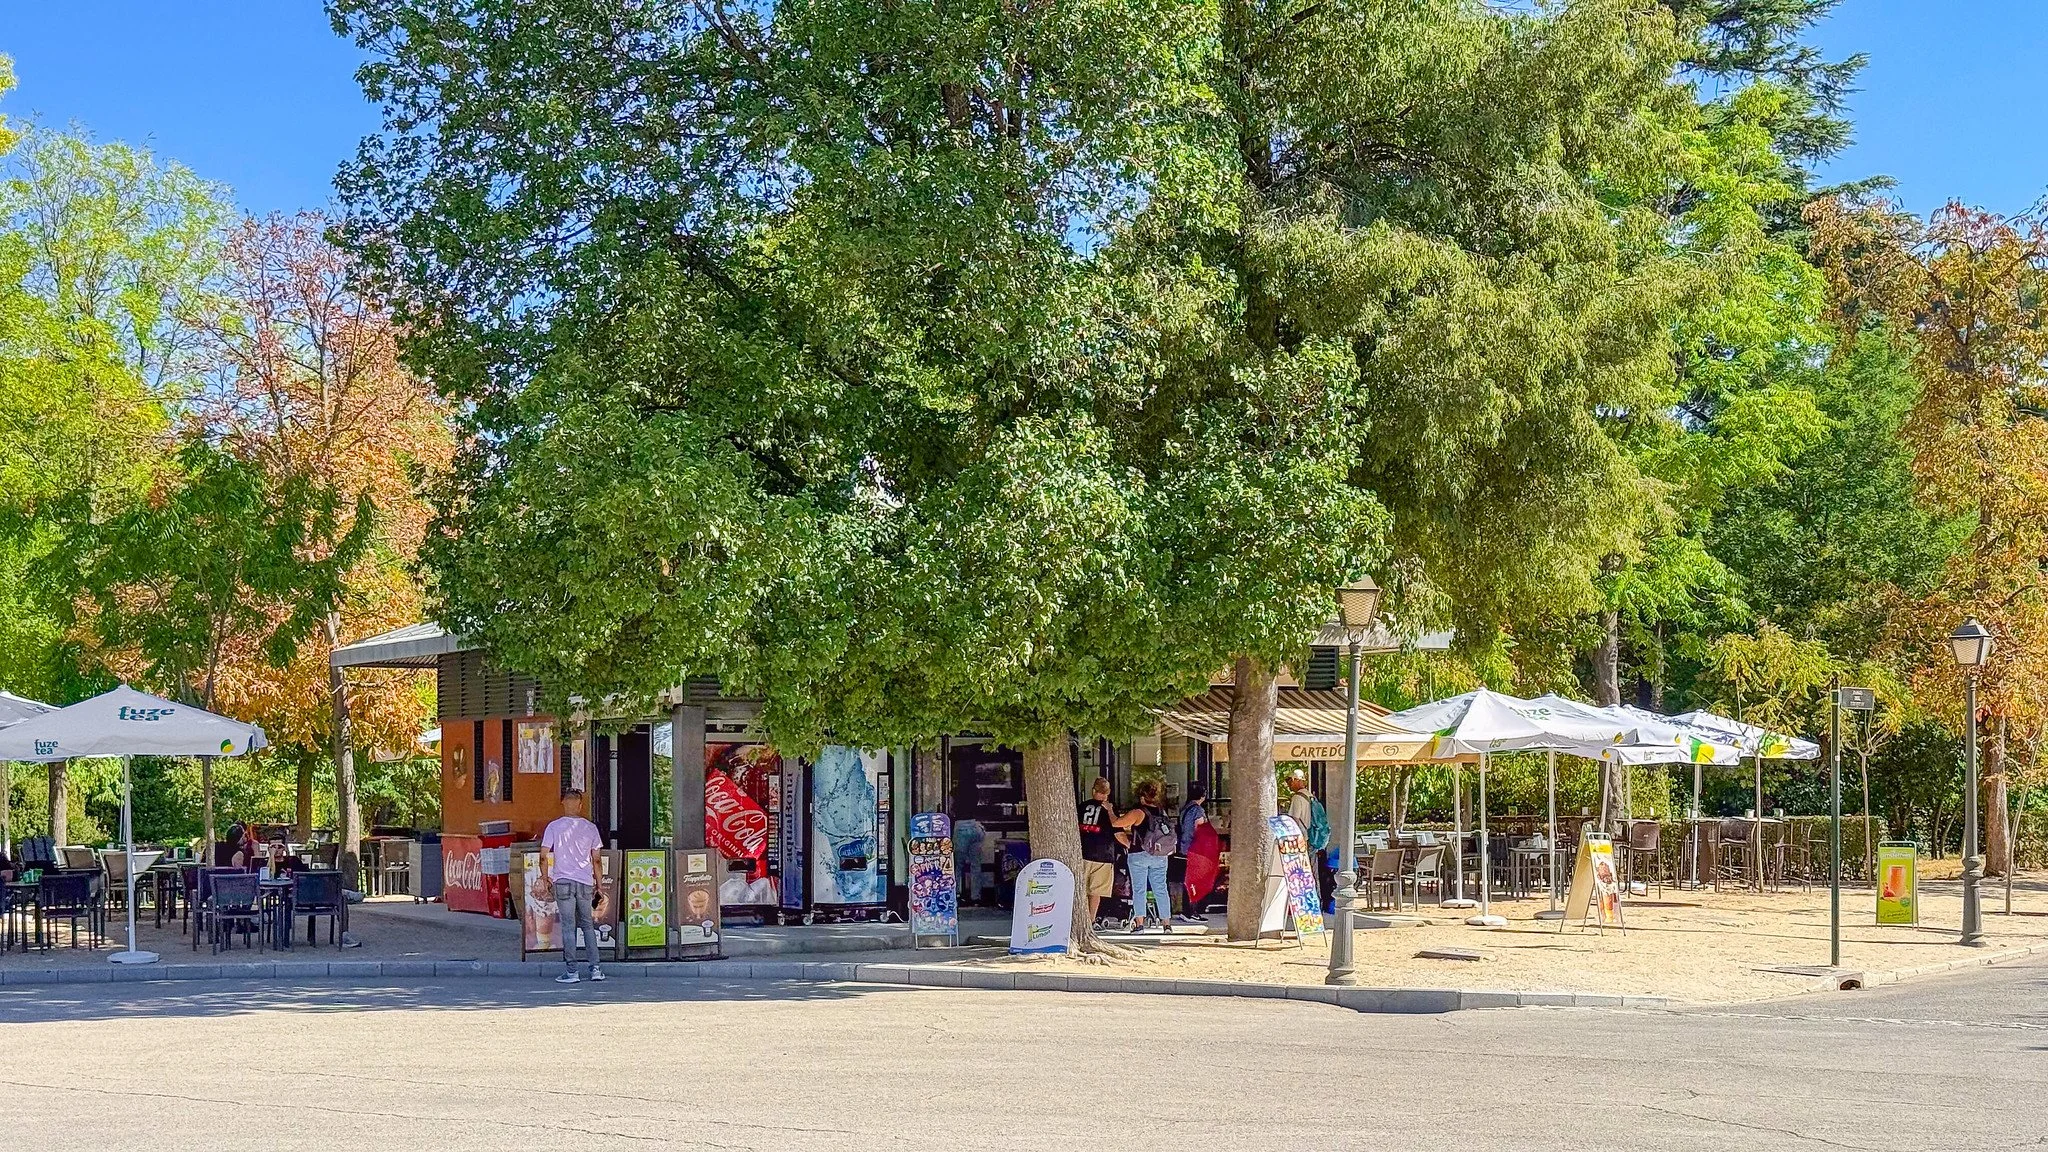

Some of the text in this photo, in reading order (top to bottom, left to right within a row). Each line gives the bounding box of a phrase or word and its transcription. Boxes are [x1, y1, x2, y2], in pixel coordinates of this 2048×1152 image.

[119, 705, 175, 716] fuze
[117, 712, 160, 721] tea
[34, 739, 59, 748] fuze
[35, 746, 54, 755] tea
[1082, 804, 1102, 825] 21
[711, 829, 745, 858] ORIGINAL
